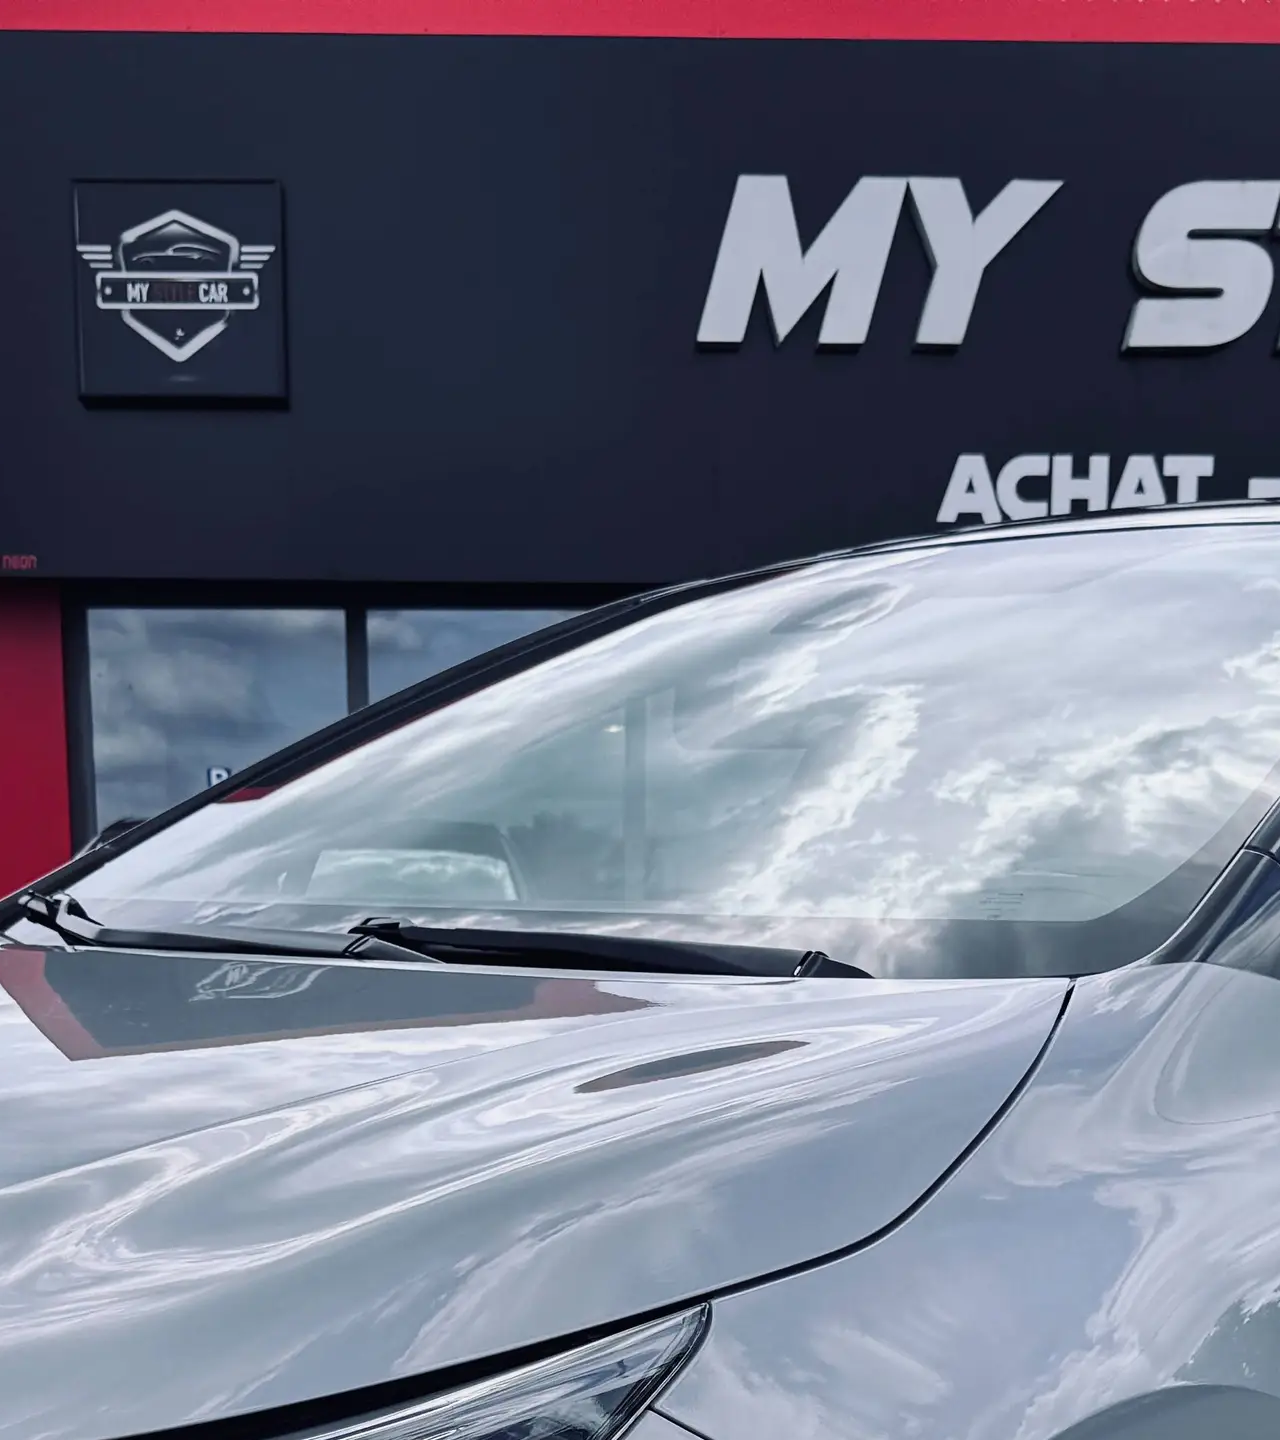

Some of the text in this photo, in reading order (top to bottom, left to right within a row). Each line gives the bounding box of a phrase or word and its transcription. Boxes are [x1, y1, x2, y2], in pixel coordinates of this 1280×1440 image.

[126, 282, 150, 303] MY
[198, 282, 229, 303] CAR
[696, 174, 1065, 350] MY
[935, 453, 1215, 525] ACHAT
